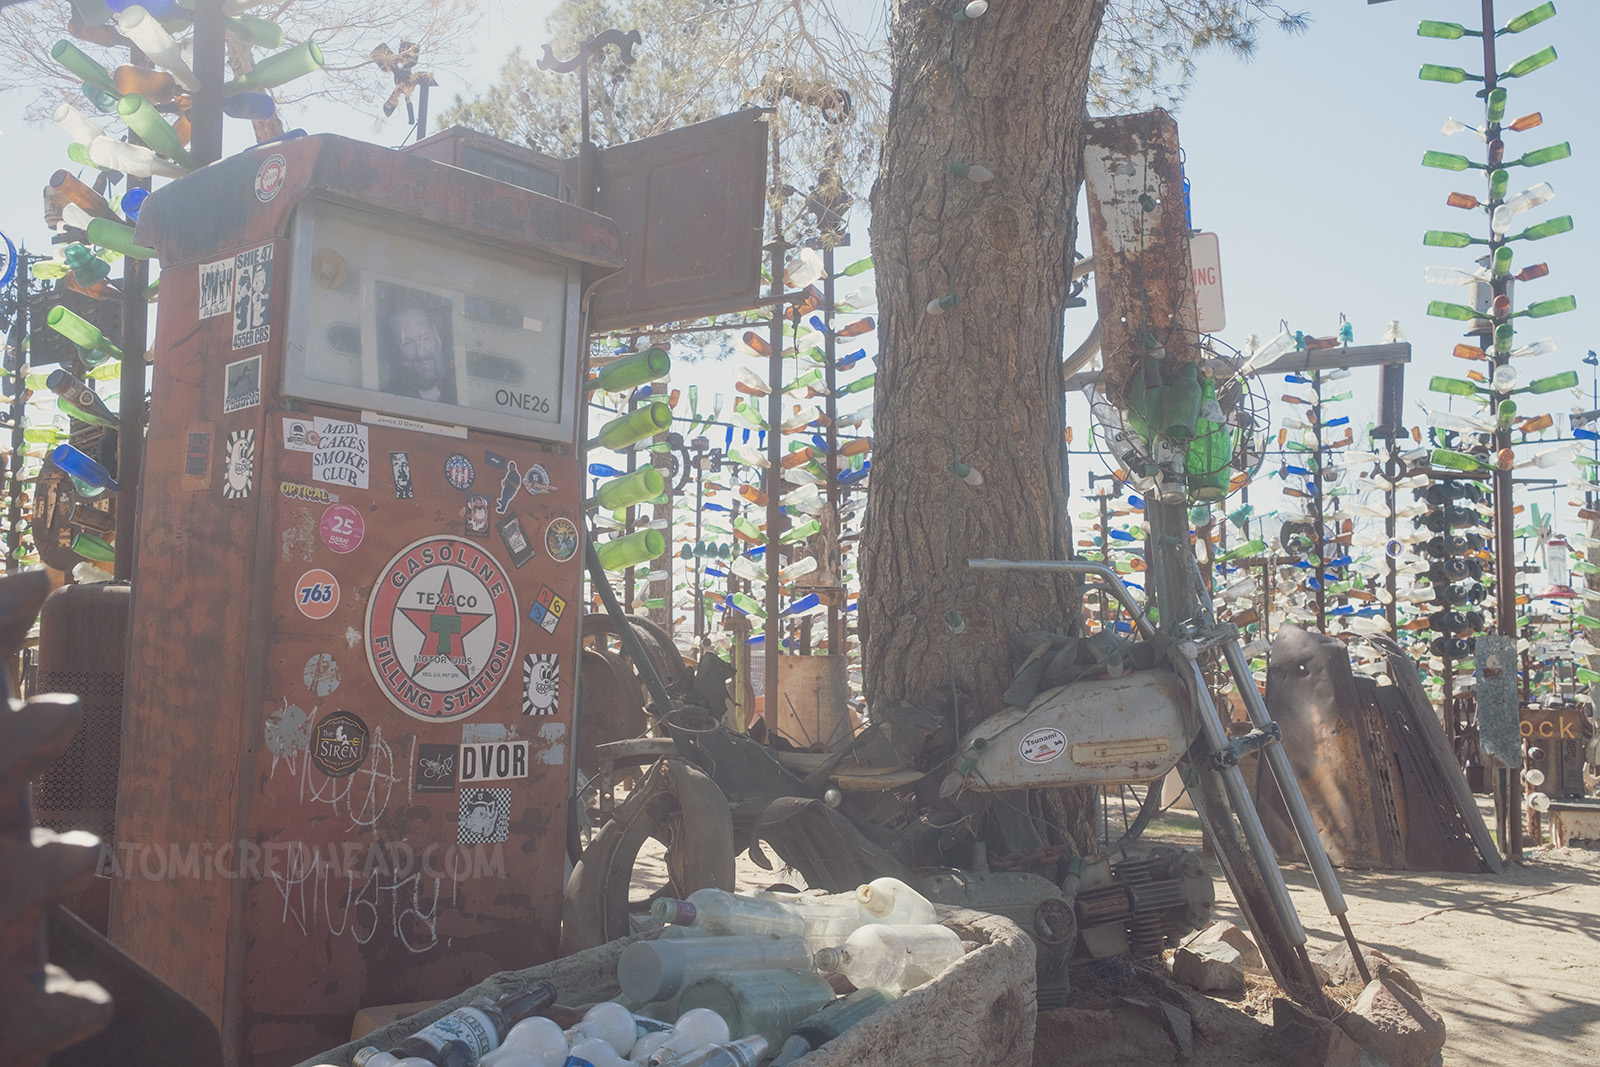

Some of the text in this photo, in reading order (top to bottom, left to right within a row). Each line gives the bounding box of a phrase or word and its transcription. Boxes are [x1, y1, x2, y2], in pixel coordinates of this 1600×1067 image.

[254, 326, 270, 343] CBS
[495, 389, 550, 414] ONE26
[322, 423, 359, 435] MEDI
[317, 436, 366, 453] CAKES
[314, 450, 368, 474] SMOKE
[323, 466, 358, 486] CLUB
[281, 482, 329, 501] OPTICAL
[331, 515, 355, 535] 25
[391, 546, 504, 598] GASOLINE
[301, 583, 335, 604] 763
[416, 592, 477, 608] TEXACO
[541, 590, 549, 600] 2
[534, 600, 562, 619] 3 6
[413, 654, 473, 666] MOTOR OILS
[375, 636, 431, 711] FILLING
[443, 641, 511, 712] STATION
[323, 729, 335, 738] THE
[1026, 732, 1058, 746] Tsunami
[320, 740, 359, 761] SIREN
[462, 744, 525, 780] DVOR
